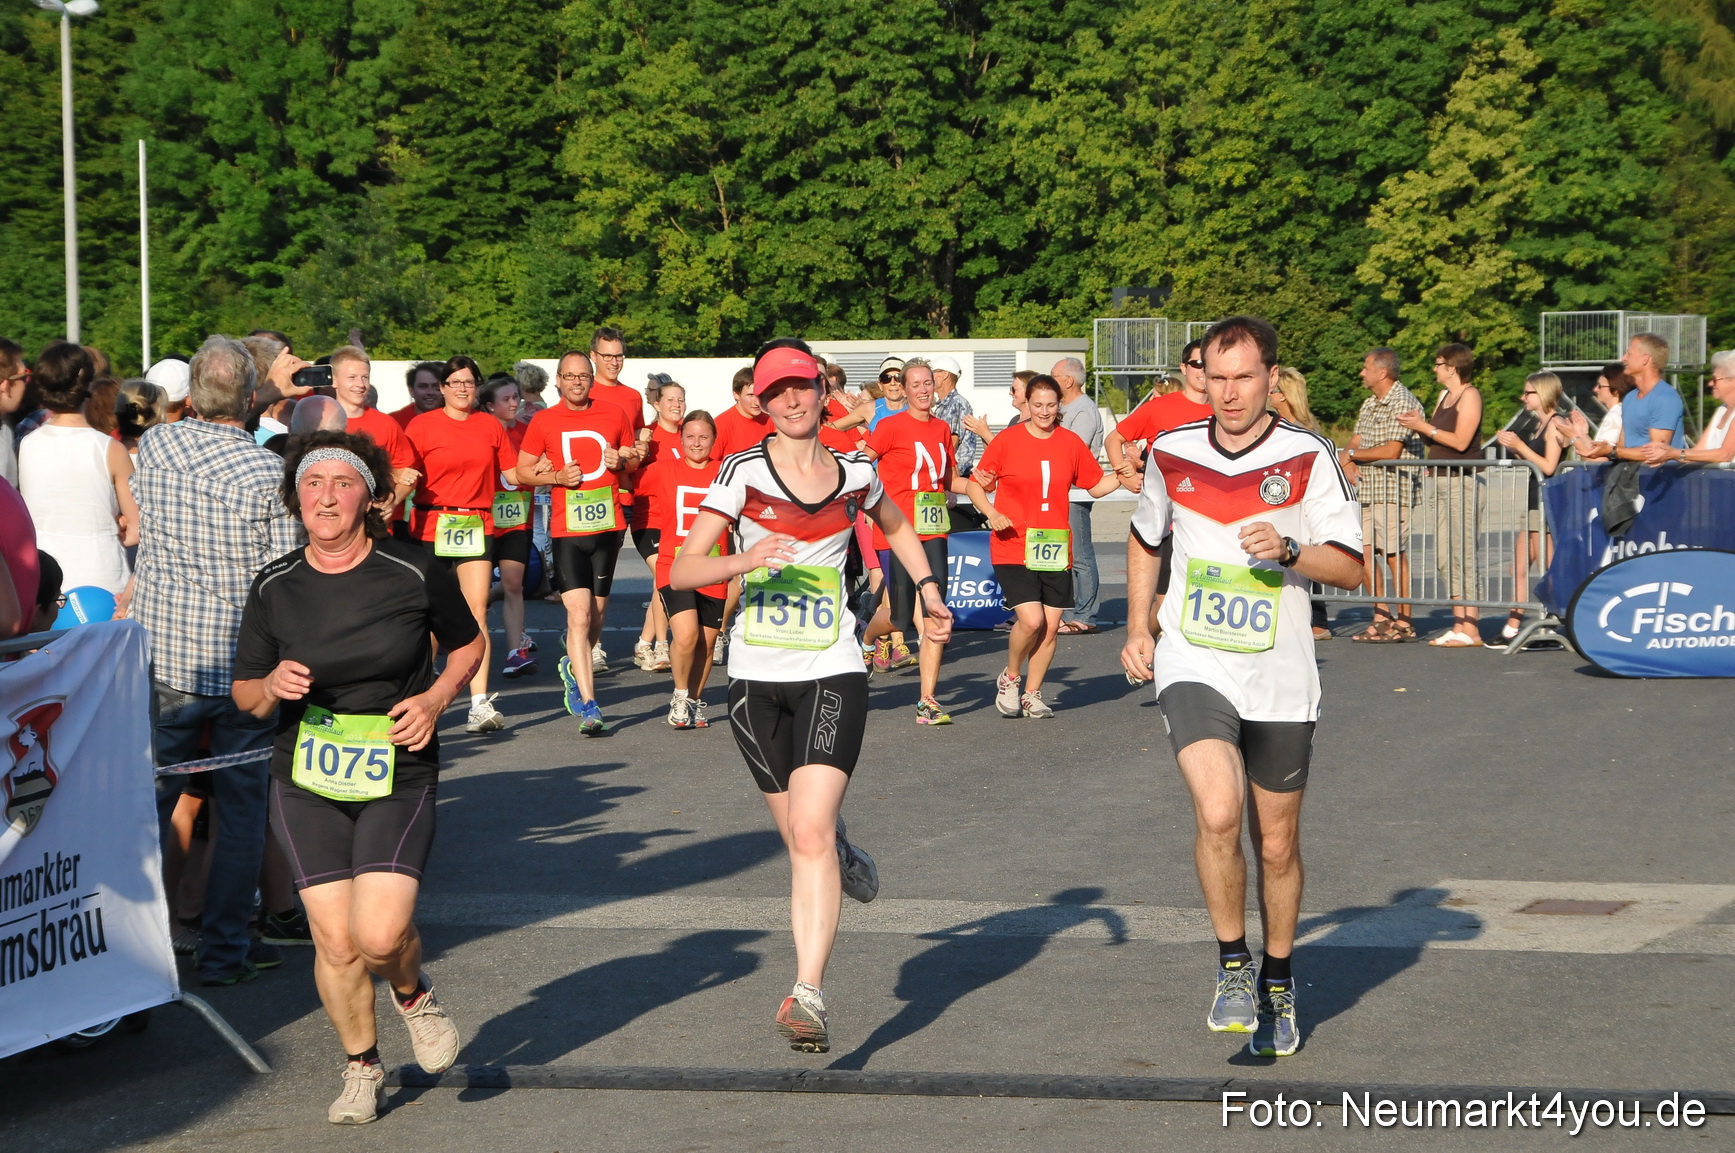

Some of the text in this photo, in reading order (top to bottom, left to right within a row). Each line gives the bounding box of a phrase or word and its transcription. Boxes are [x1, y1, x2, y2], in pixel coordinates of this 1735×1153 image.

[561, 430, 608, 482] D
[911, 441, 947, 490] N
[1040, 460, 1051, 511] !
[497, 503, 521, 519] 164
[573, 503, 607, 522] 189
[676, 485, 710, 537] E
[921, 506, 943, 524] 181
[443, 529, 473, 546] 161
[1032, 543, 1062, 560] 167
[750, 590, 835, 629] 1316
[1188, 588, 1273, 633] 1306
[814, 689, 842, 755] 2XU
[299, 737, 389, 781] 1075
[330, 785, 348, 793] Wagner
